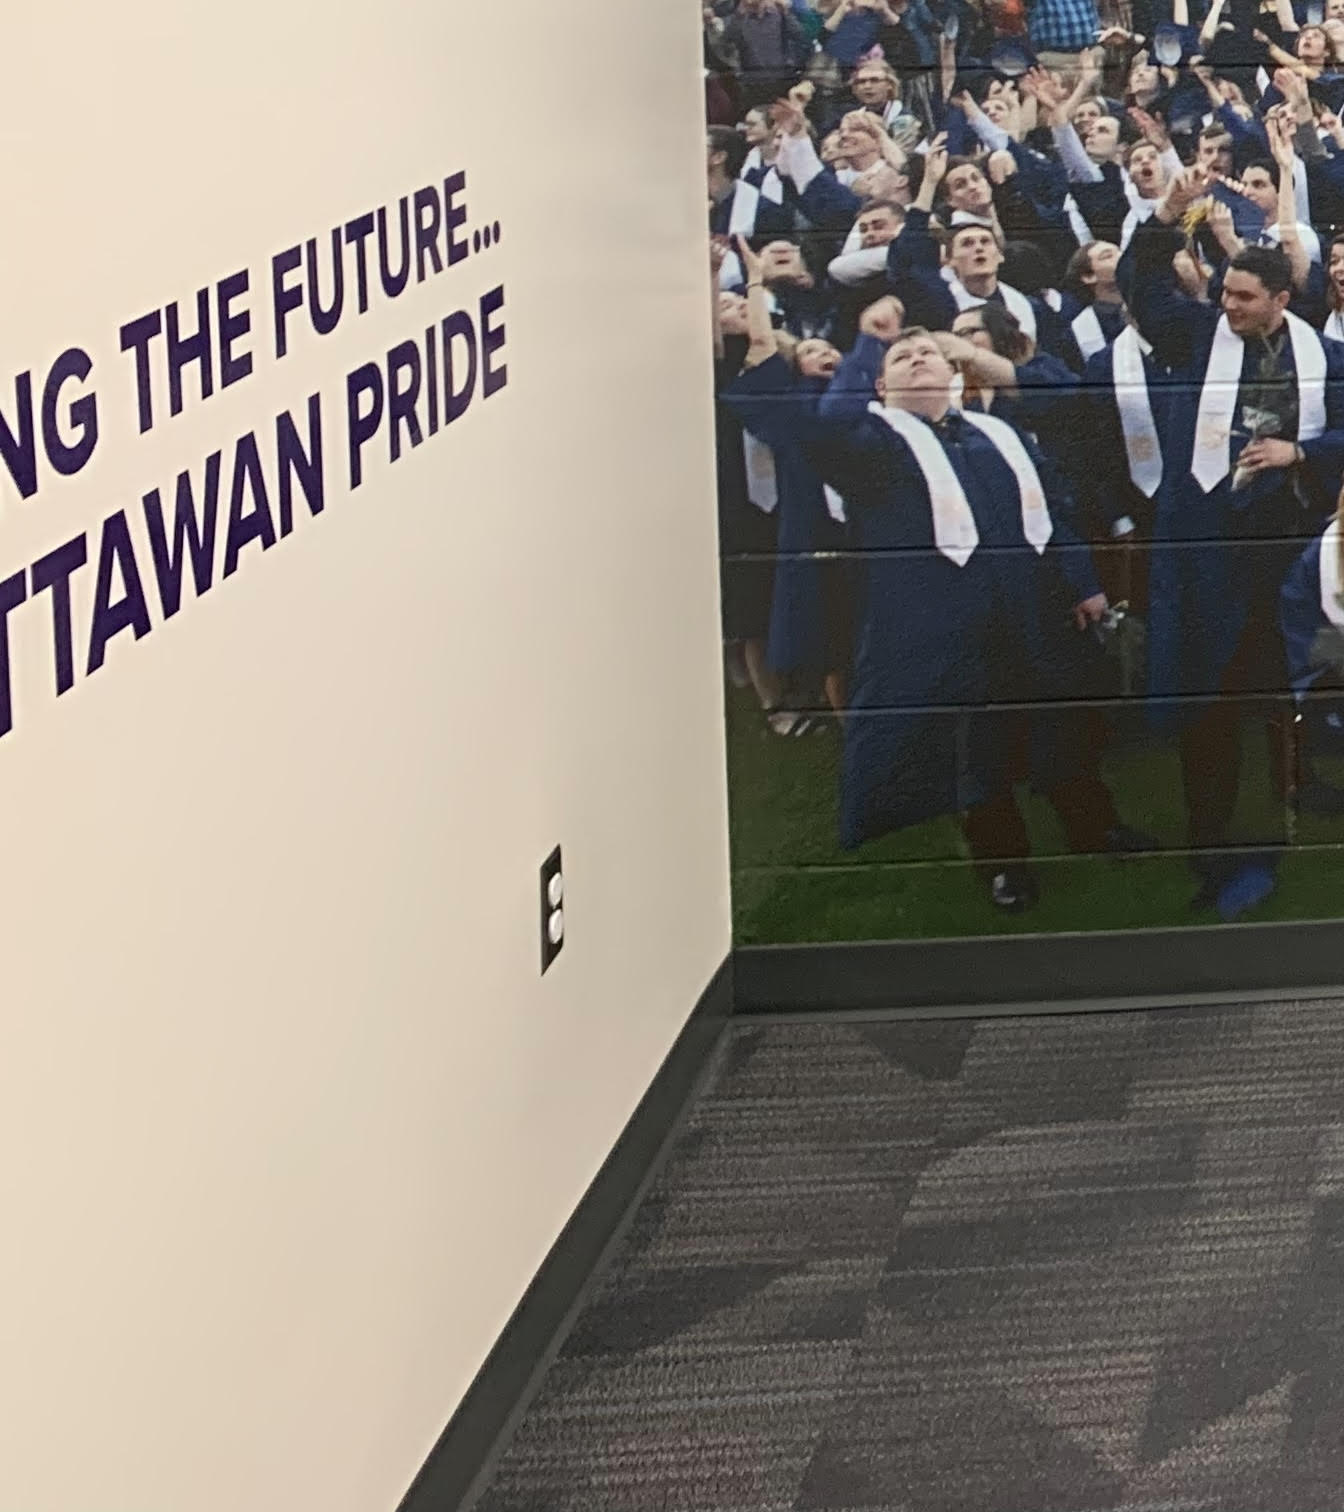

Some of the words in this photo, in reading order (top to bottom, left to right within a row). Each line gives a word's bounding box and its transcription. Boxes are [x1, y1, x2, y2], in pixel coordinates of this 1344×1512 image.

[119, 268, 253, 435] THE
[272, 170, 501, 359] FUTURE...
[346, 284, 508, 491] PRIDE
